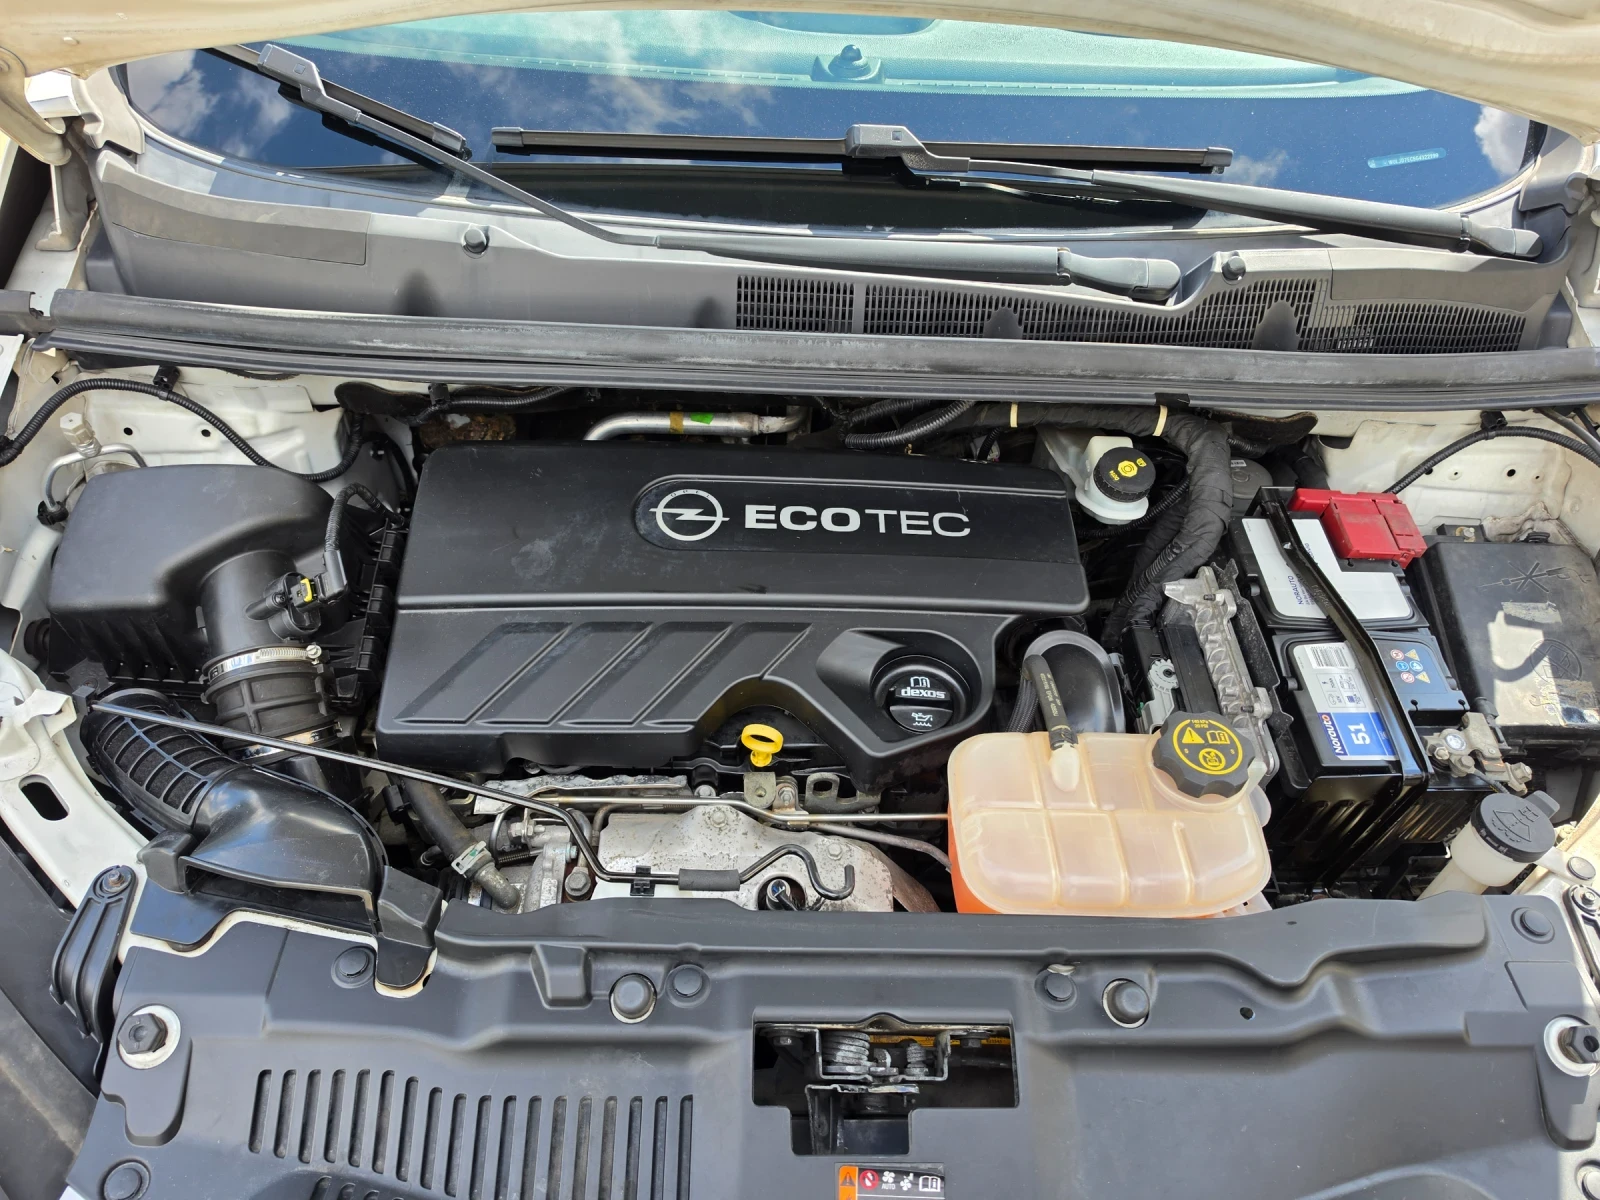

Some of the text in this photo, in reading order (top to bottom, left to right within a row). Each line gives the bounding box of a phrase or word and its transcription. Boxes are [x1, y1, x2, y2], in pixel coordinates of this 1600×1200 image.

[744, 504, 971, 537] ECOTEC
[1287, 575, 1304, 605] NORAUTO
[900, 686, 946, 699] dexos
[1321, 714, 1344, 755] Norauto
[1347, 723, 1371, 745] 51
